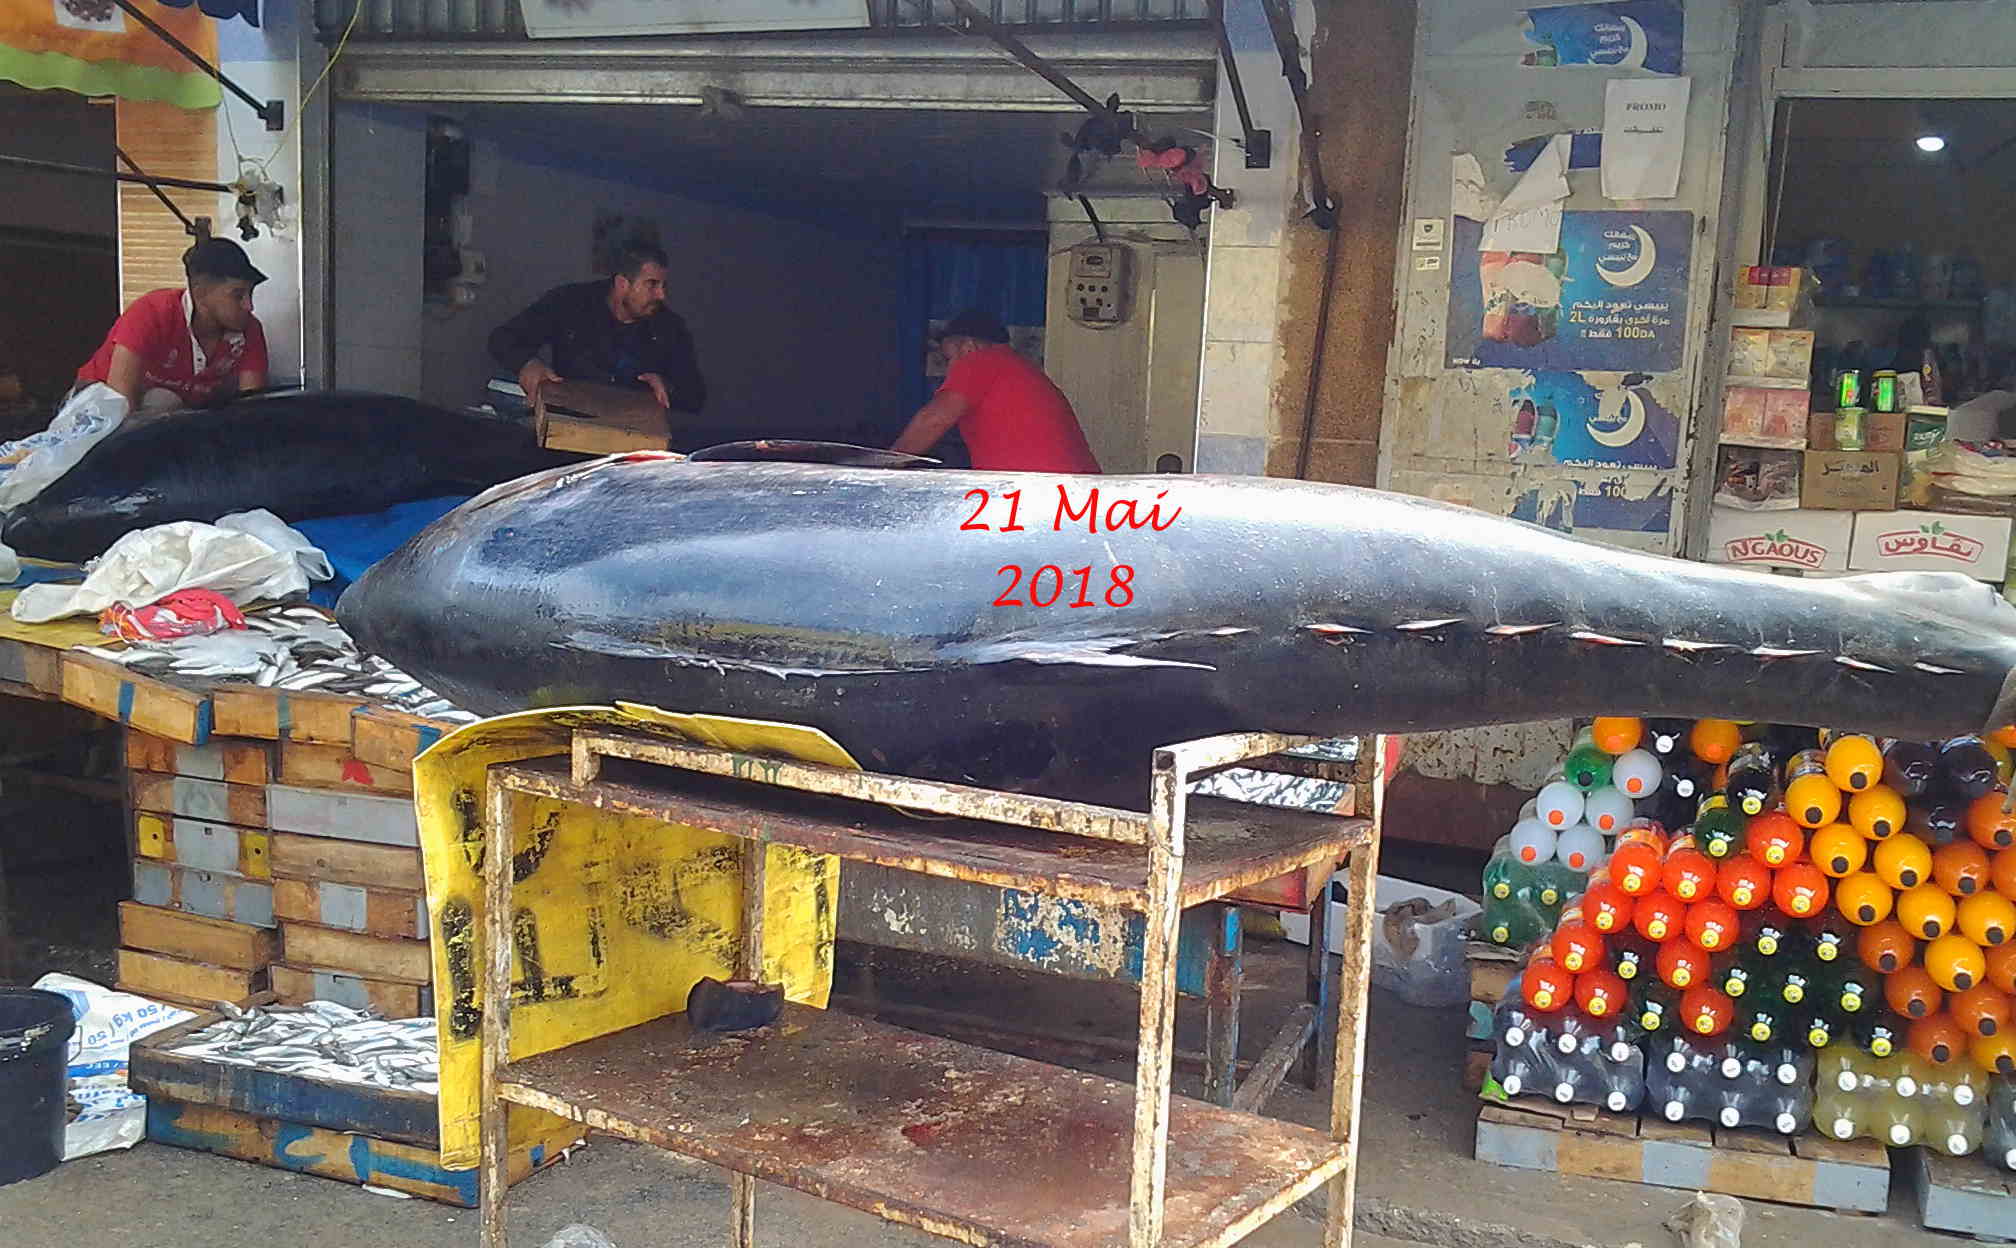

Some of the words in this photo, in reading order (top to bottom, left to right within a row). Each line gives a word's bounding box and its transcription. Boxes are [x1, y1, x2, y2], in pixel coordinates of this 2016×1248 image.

[1568, 311, 1586, 323] 2L
[1883, 535, 1975, 557] نقاوس
[137, 1003, 159, 1018] 50
[111, 1010, 134, 1029] kg
